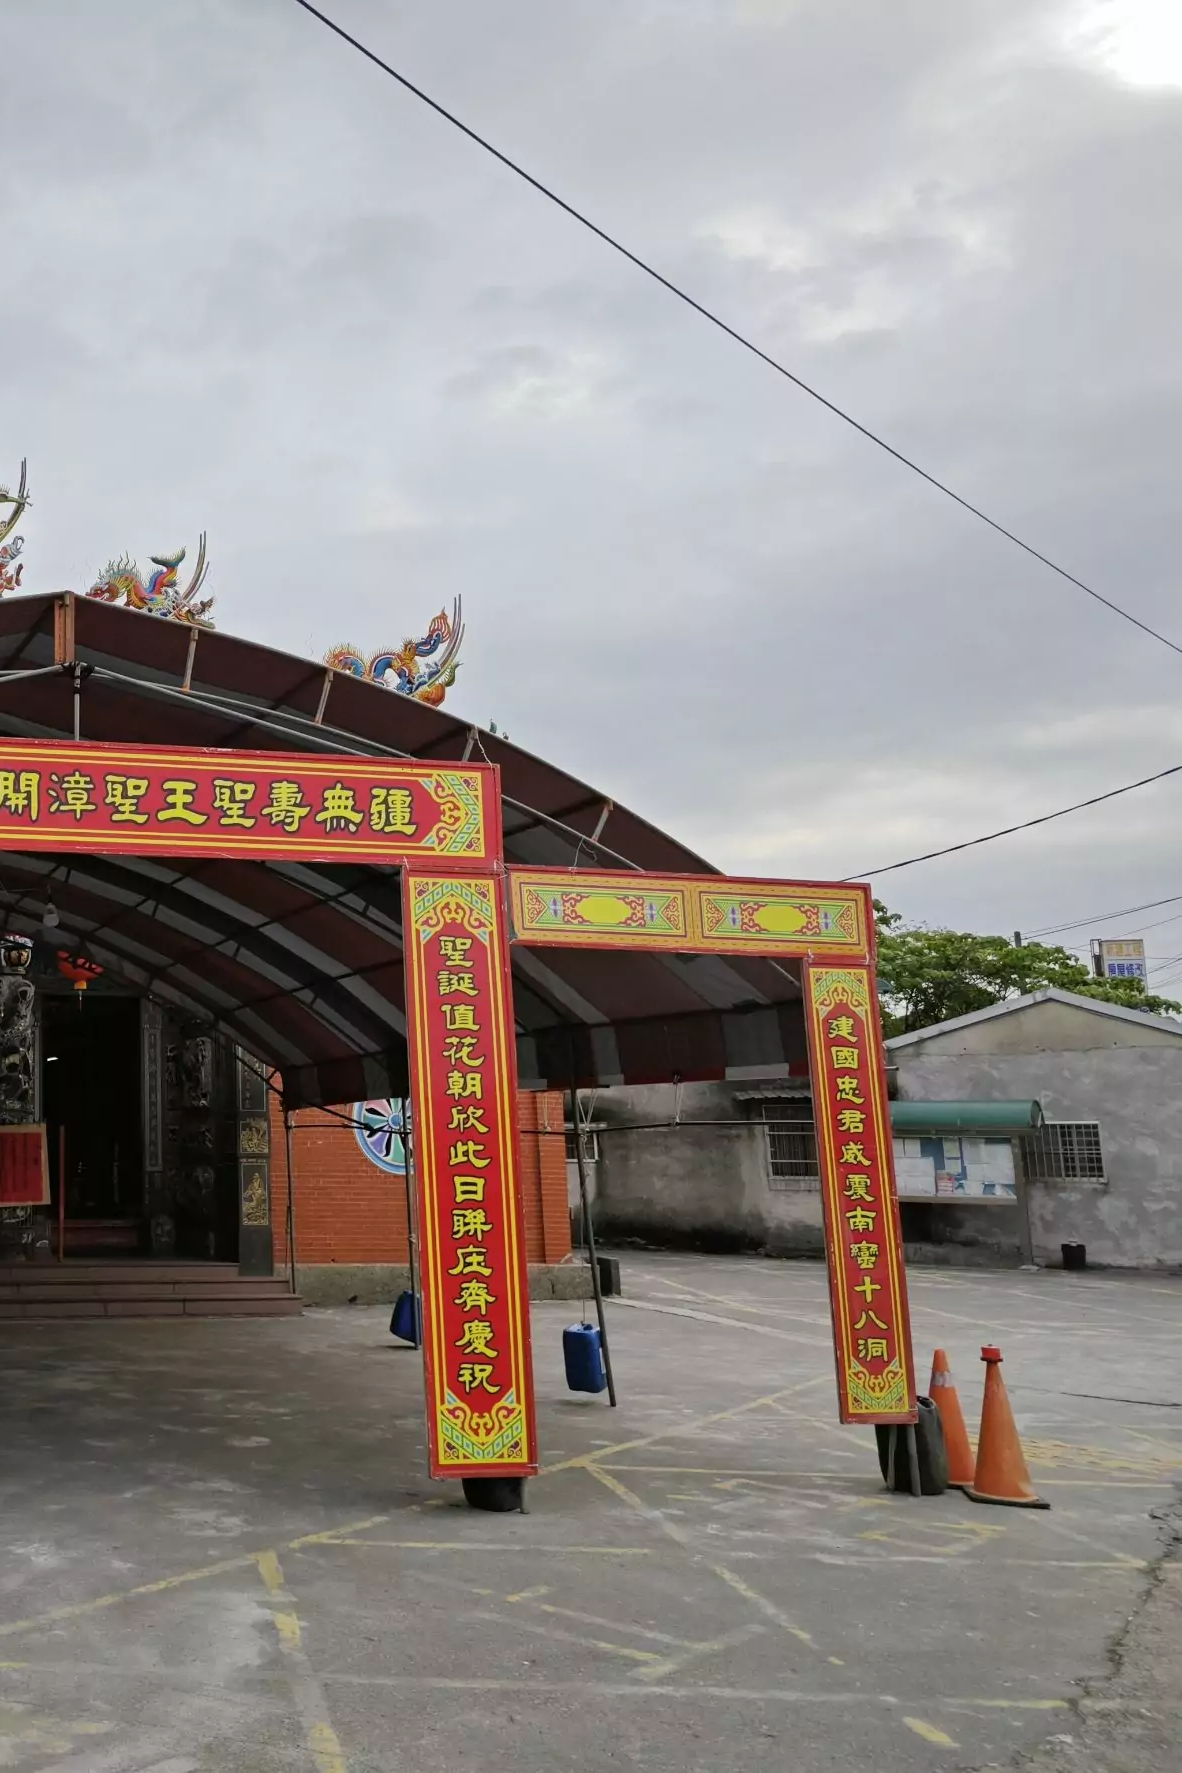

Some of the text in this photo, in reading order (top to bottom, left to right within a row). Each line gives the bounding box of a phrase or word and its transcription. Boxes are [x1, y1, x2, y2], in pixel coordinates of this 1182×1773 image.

[827, 1015, 889, 1363] 建國忠君威震南蠻十八洞
